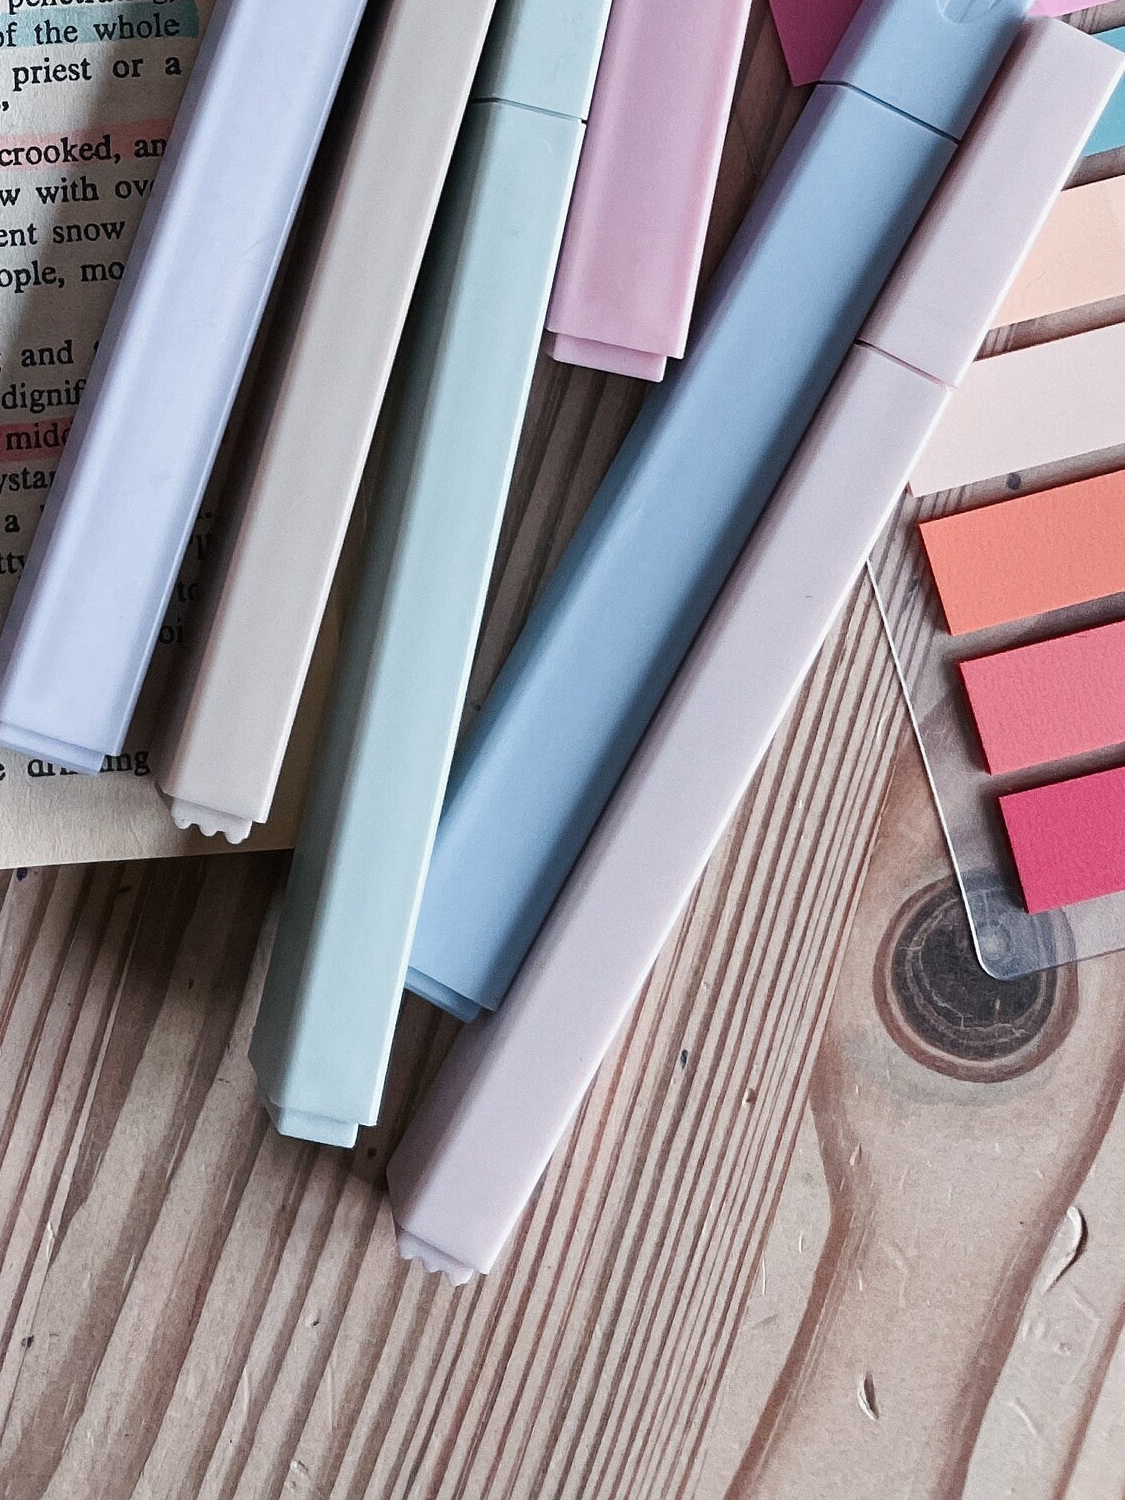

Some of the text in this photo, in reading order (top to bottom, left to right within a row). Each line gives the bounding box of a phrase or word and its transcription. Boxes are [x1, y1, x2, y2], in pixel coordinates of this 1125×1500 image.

[33, 18, 79, 46] the
[92, 11, 181, 42] whole
[52, 220, 126, 245] snow
[4, 514, 21, 534] a
